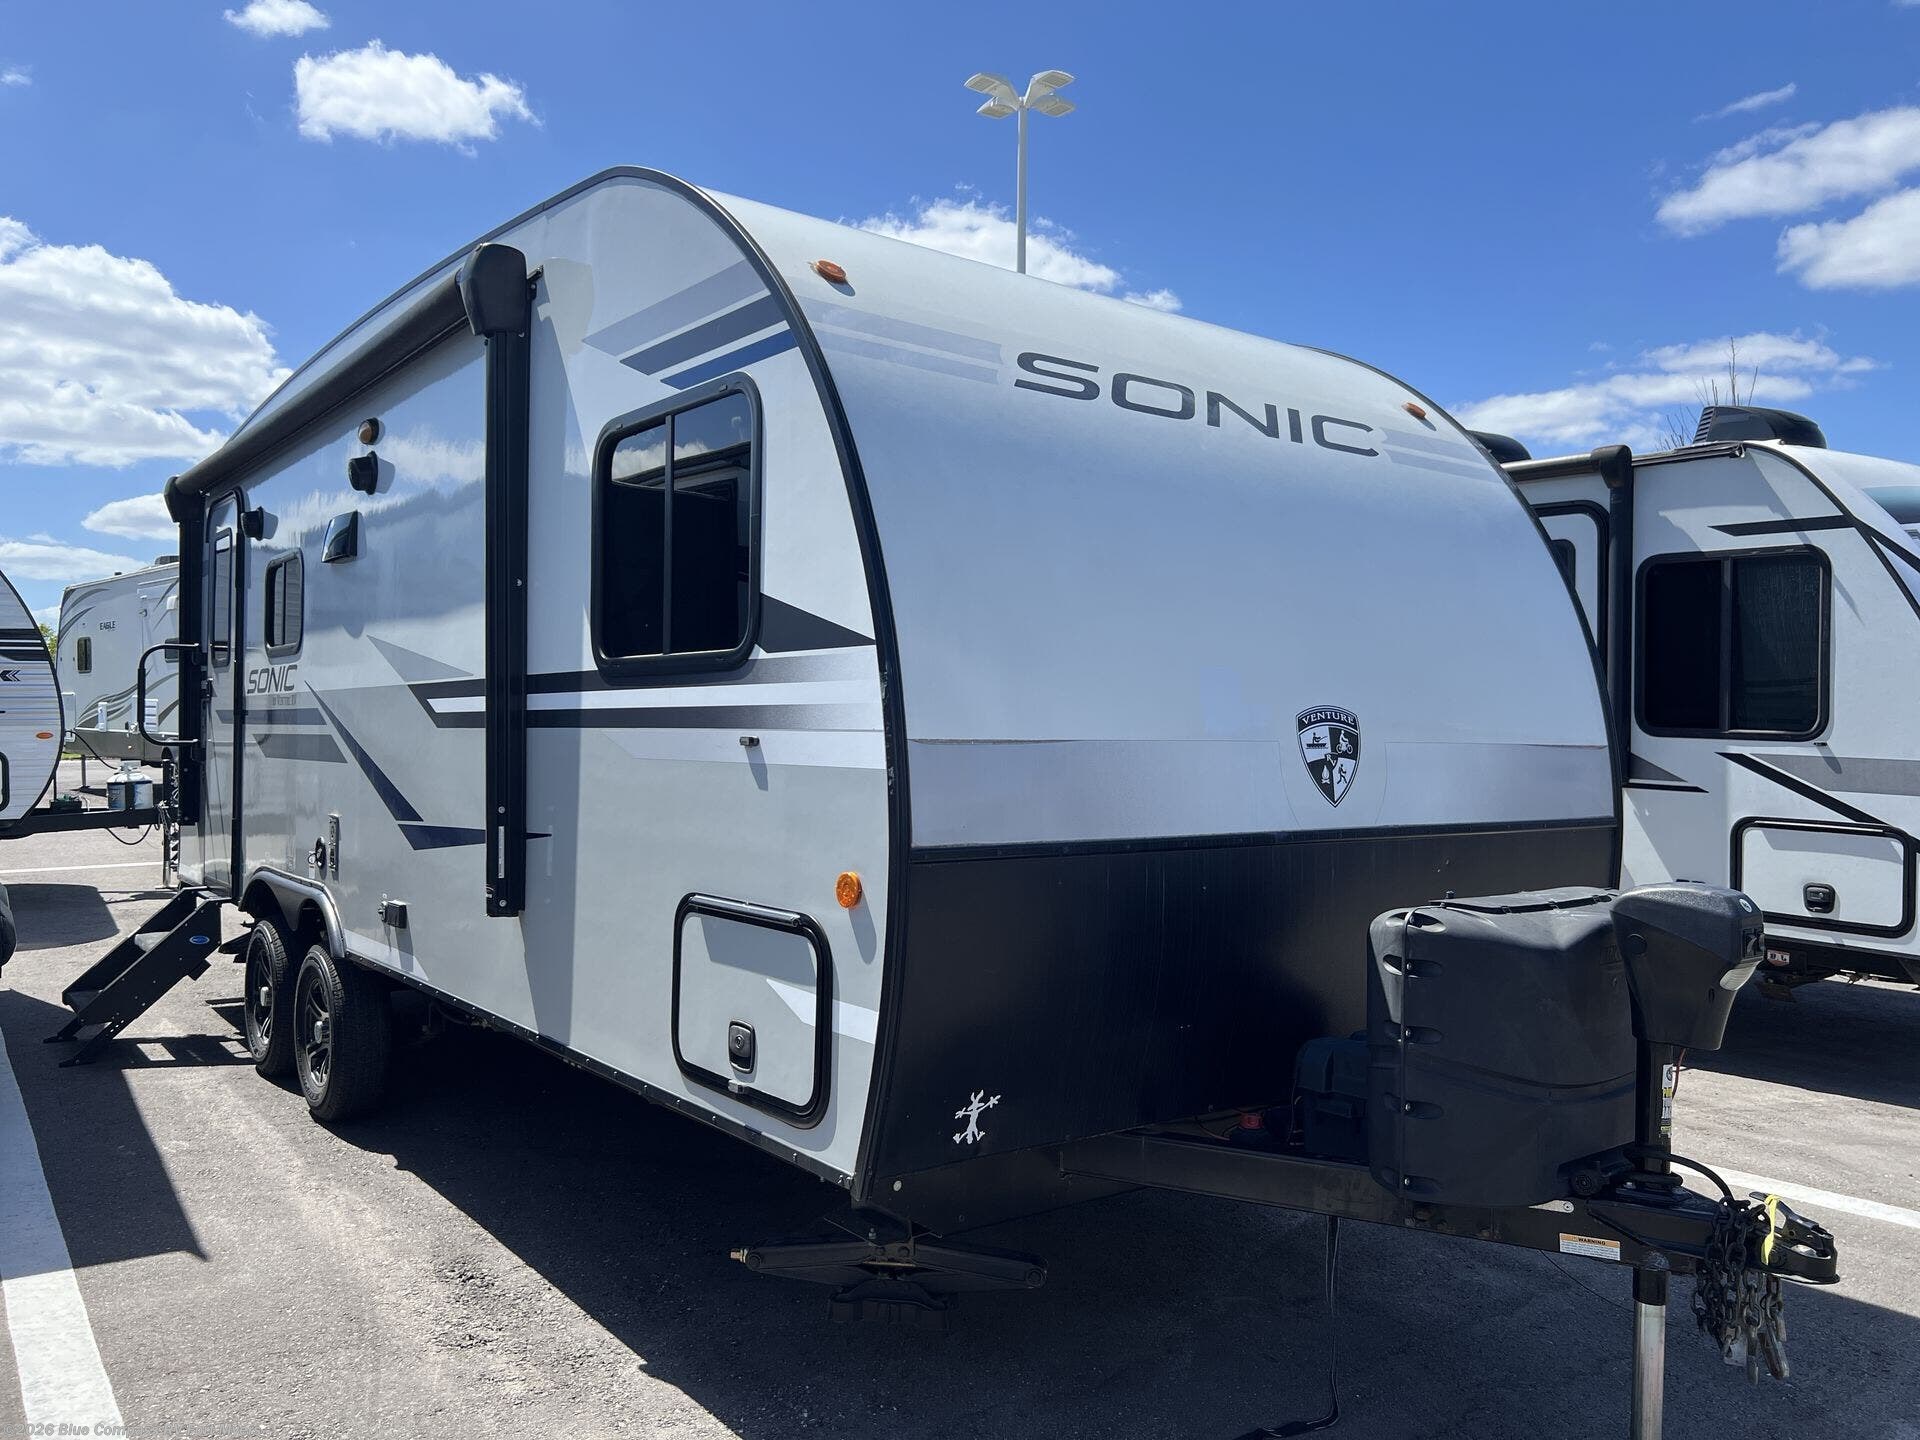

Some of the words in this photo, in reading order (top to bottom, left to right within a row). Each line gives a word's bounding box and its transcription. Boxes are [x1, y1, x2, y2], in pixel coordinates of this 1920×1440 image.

[1014, 352, 1379, 457] SONIC
[100, 620, 116, 631] EAGLE
[247, 664, 298, 694] SONIC
[1302, 711, 1355, 725] VENTURE
[1326, 754, 1337, 767] RV
[1578, 1237, 1606, 1246] WARNING
